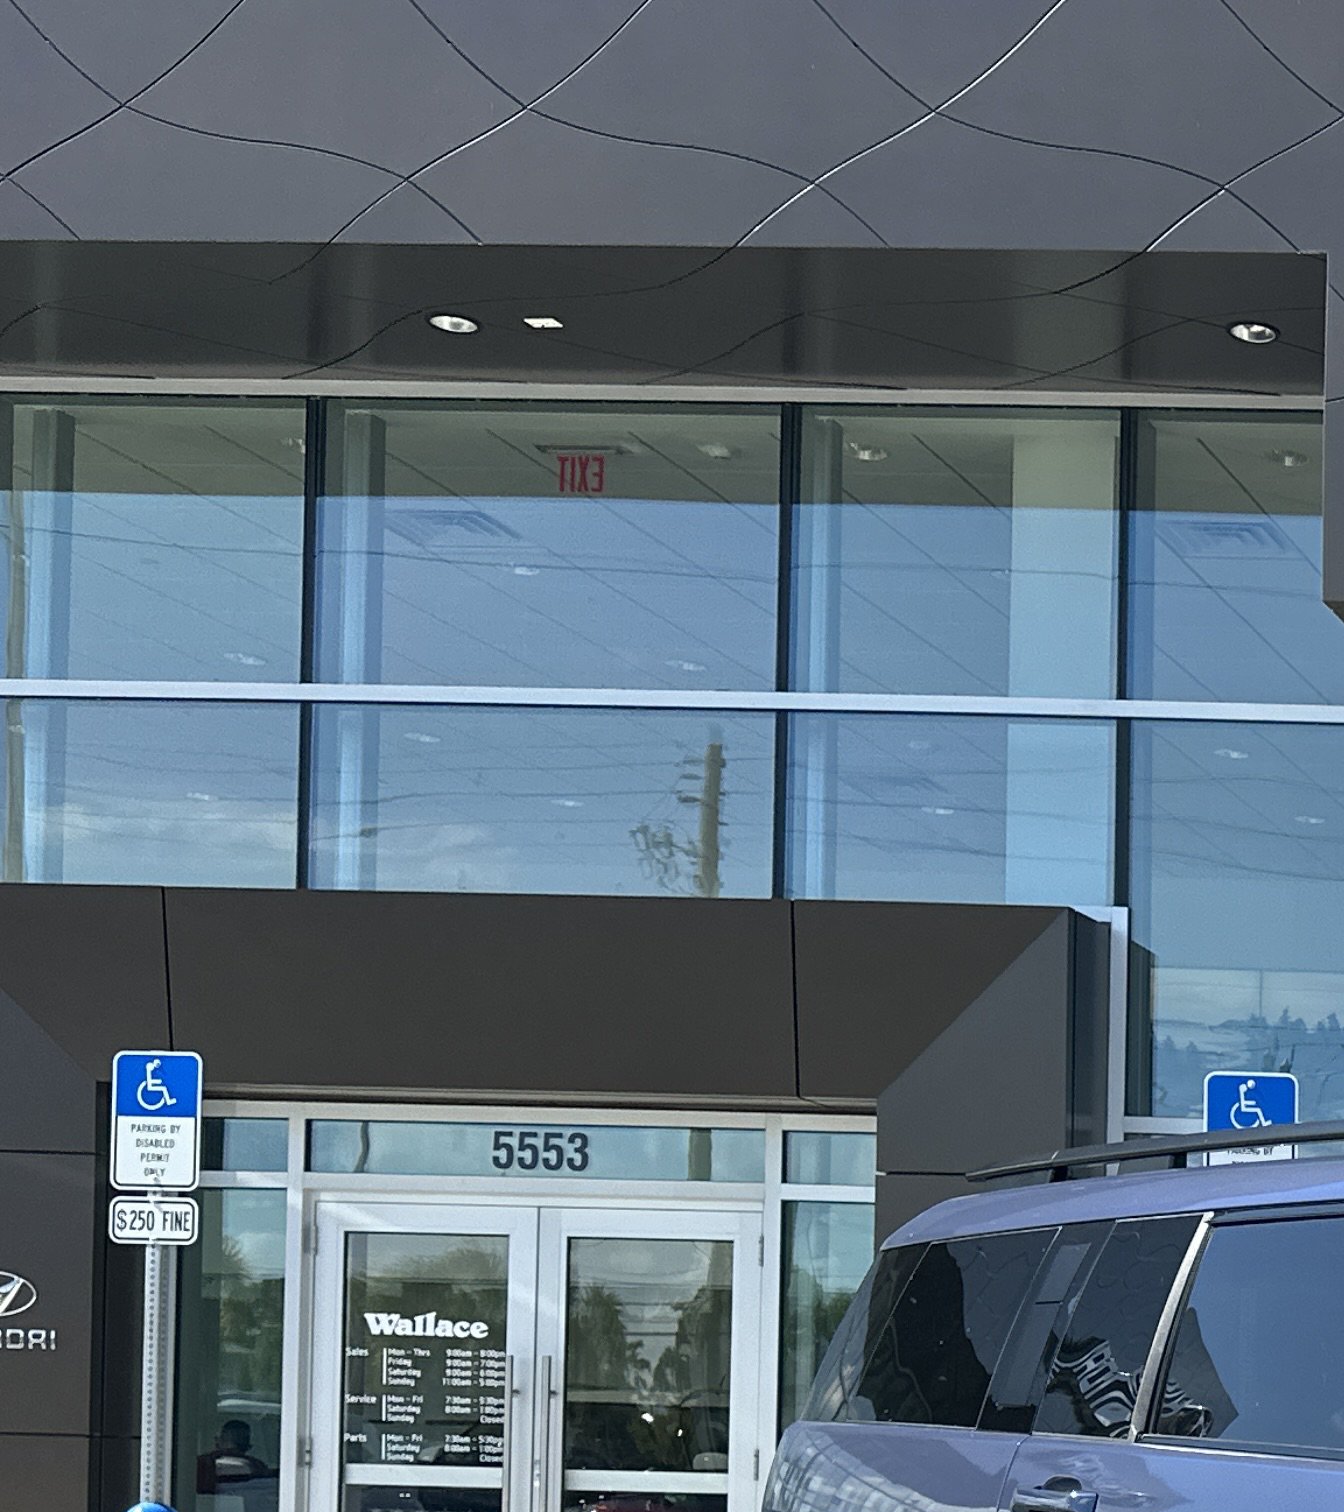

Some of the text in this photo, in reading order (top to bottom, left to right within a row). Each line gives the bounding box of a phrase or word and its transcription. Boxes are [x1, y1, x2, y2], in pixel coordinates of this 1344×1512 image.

[131, 1124, 181, 1134] PARKING BY
[136, 1138, 176, 1149] DISABLED
[492, 1130, 589, 1172] 5553
[140, 1153, 170, 1163] PERMIT
[144, 1167, 166, 1177] ONLY
[116, 1208, 191, 1232] $250 FINE
[363, 1311, 489, 1339] Wallace
[0, 1328, 56, 1350] DAI
[345, 1346, 369, 1357] Sales
[388, 1357, 412, 1367] Friday
[388, 1367, 421, 1378] Saturday
[388, 1377, 415, 1387] Sunday
[345, 1394, 377, 1404] Service
[387, 1404, 421, 1415] Saturday
[387, 1413, 415, 1424] Sunday
[344, 1432, 367, 1442] Parts
[386, 1442, 421, 1454] Saturday
[387, 1452, 414, 1463] Sunday
